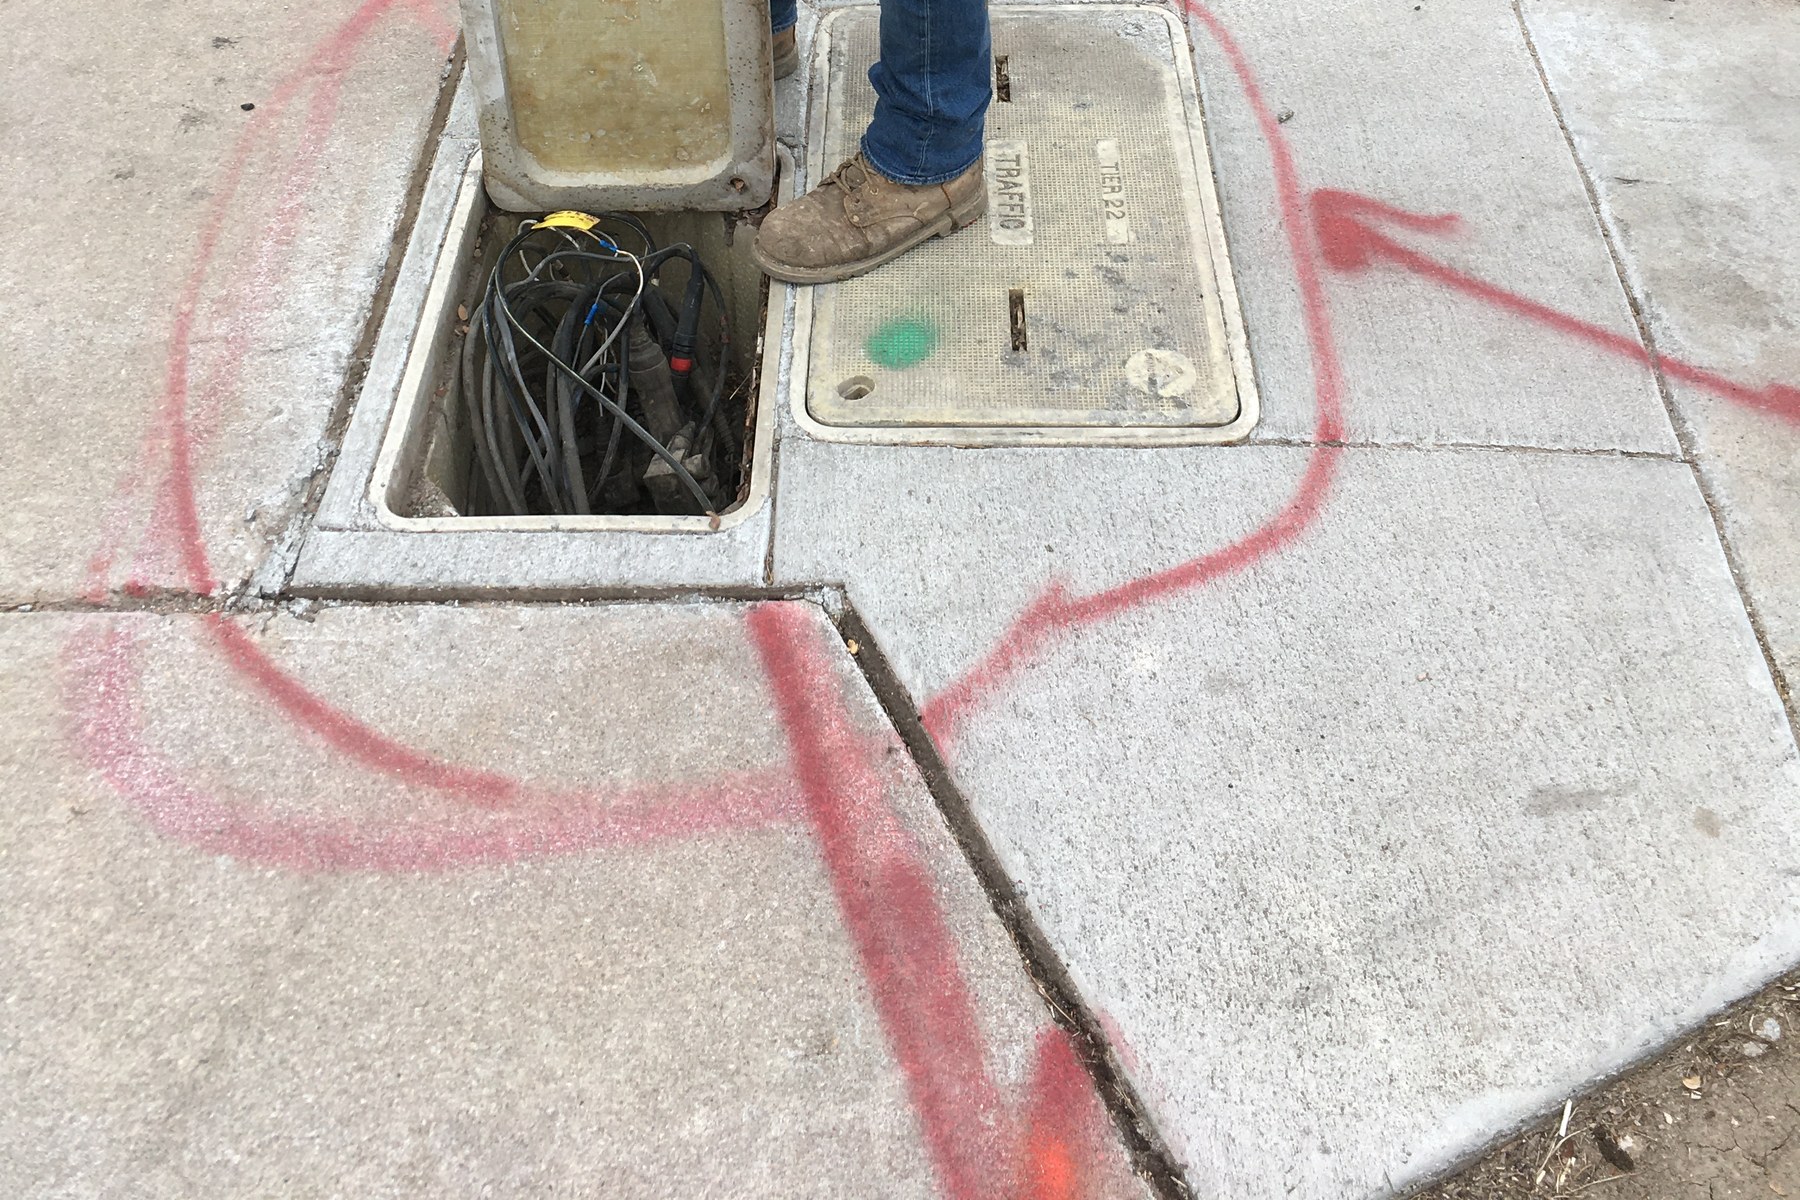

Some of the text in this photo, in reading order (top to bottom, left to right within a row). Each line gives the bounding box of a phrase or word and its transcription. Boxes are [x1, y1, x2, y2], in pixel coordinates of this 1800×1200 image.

[995, 154, 1025, 229] TRAFFIC
[1101, 161, 1125, 220] TIER 22
